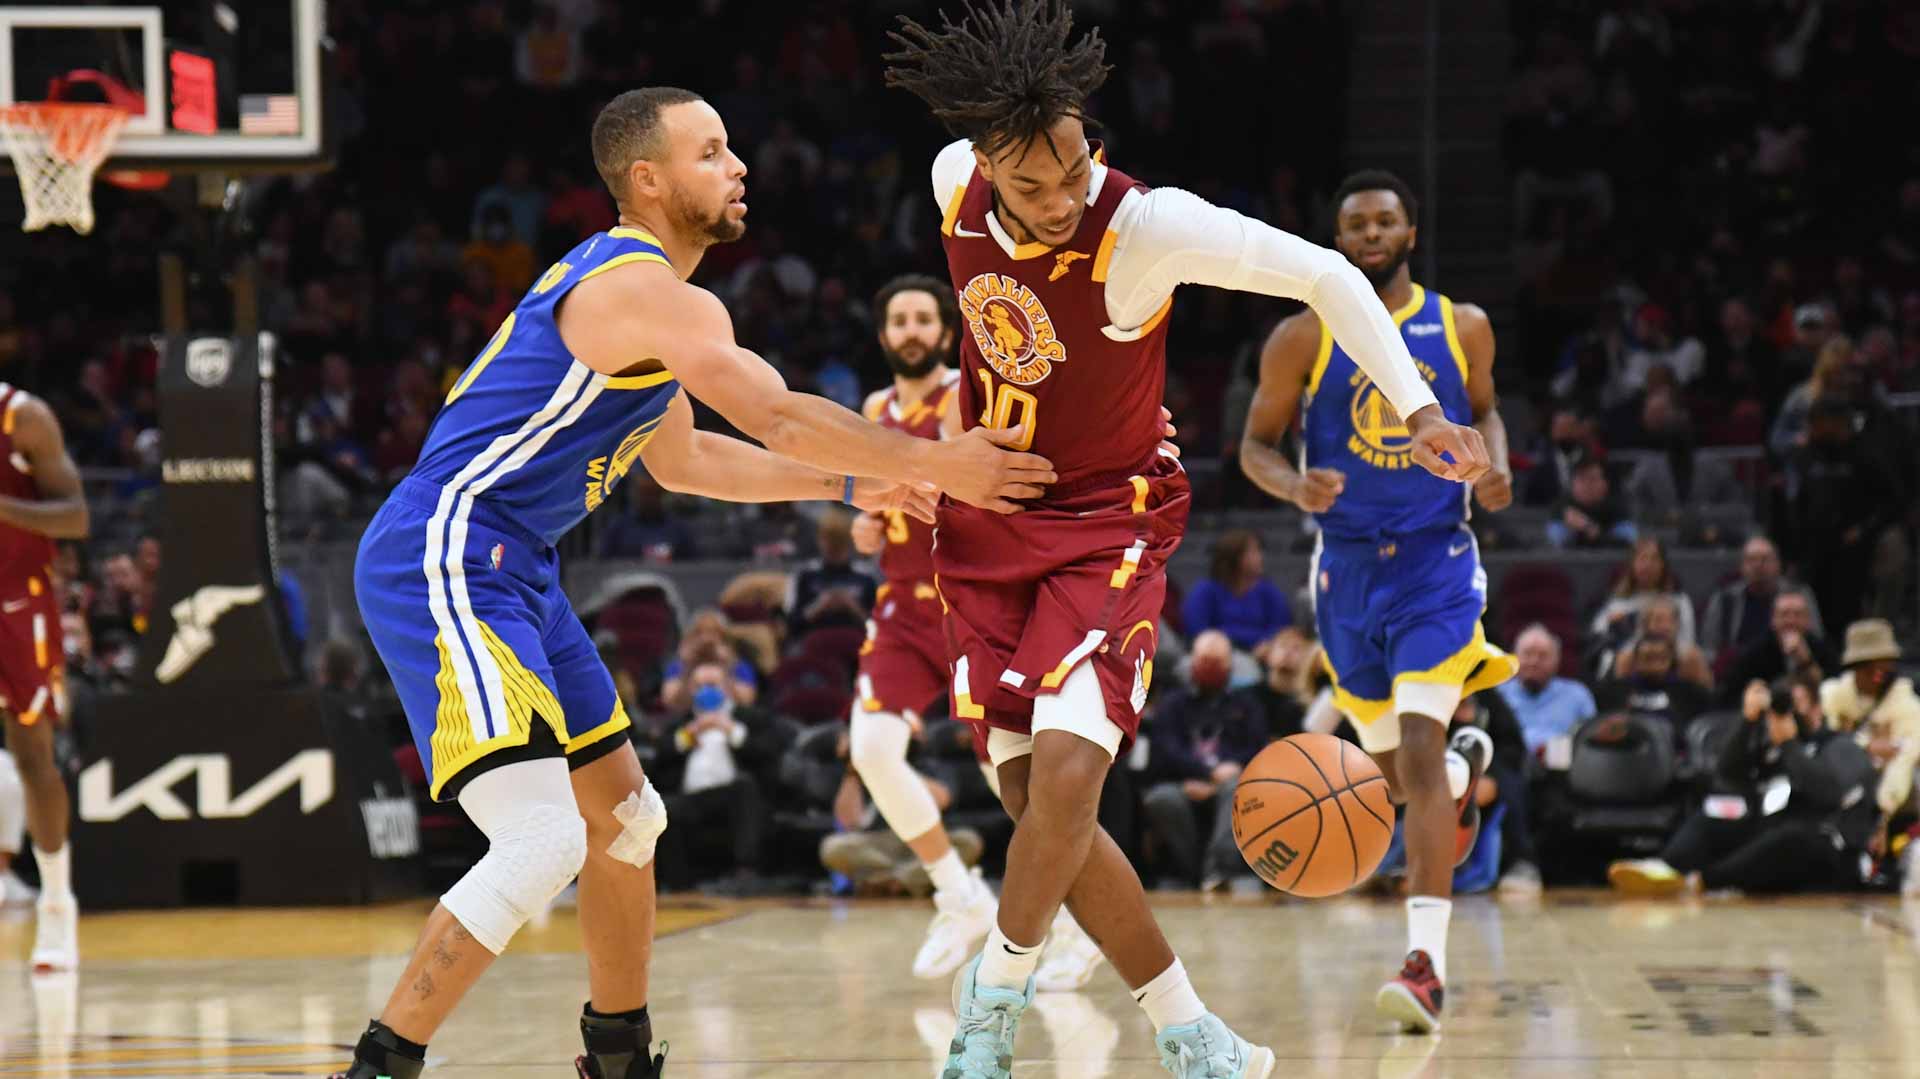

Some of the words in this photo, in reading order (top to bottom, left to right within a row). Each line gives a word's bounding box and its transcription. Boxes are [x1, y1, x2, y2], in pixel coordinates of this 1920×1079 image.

[960, 273, 1066, 361] CAVALIERS
[970, 322, 1052, 386] CLEVELAND
[978, 368, 1039, 452] 10
[1347, 434, 1412, 470] WARRI
